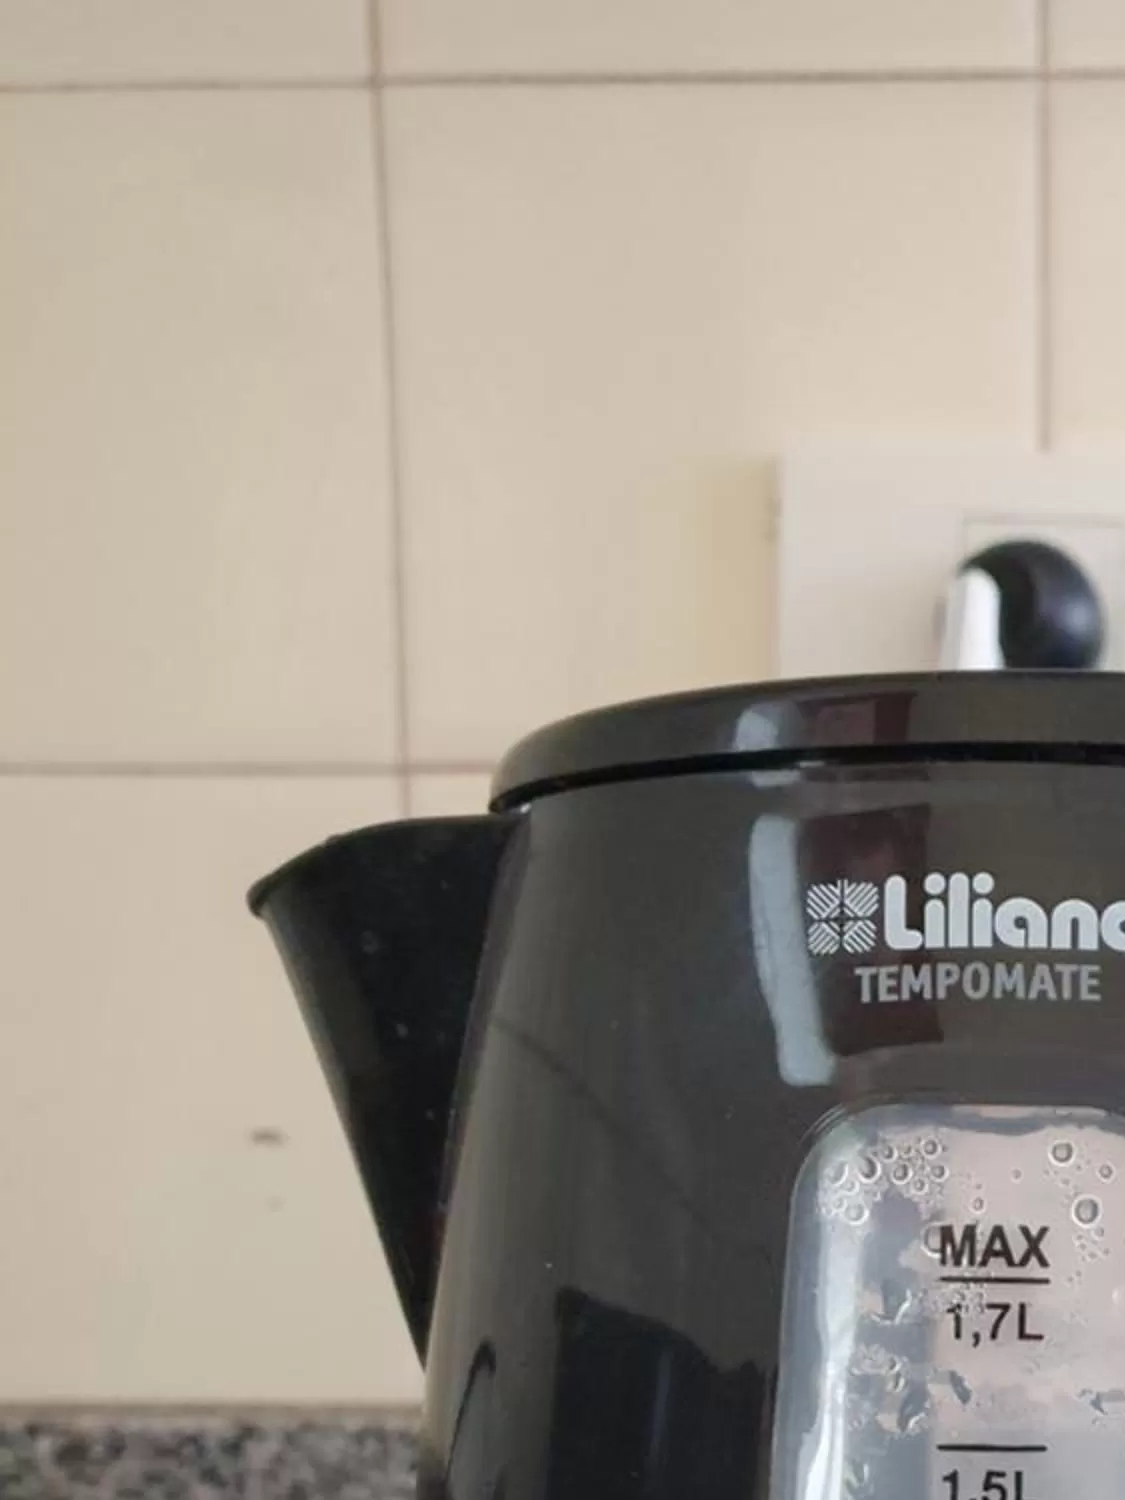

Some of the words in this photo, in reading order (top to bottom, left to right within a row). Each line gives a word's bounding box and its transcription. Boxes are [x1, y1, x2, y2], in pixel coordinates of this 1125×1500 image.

[854, 960, 1103, 1004] TEMPOMATE
[938, 1223, 1051, 1269] MAX
[945, 1302, 1045, 1348] 1,7L
